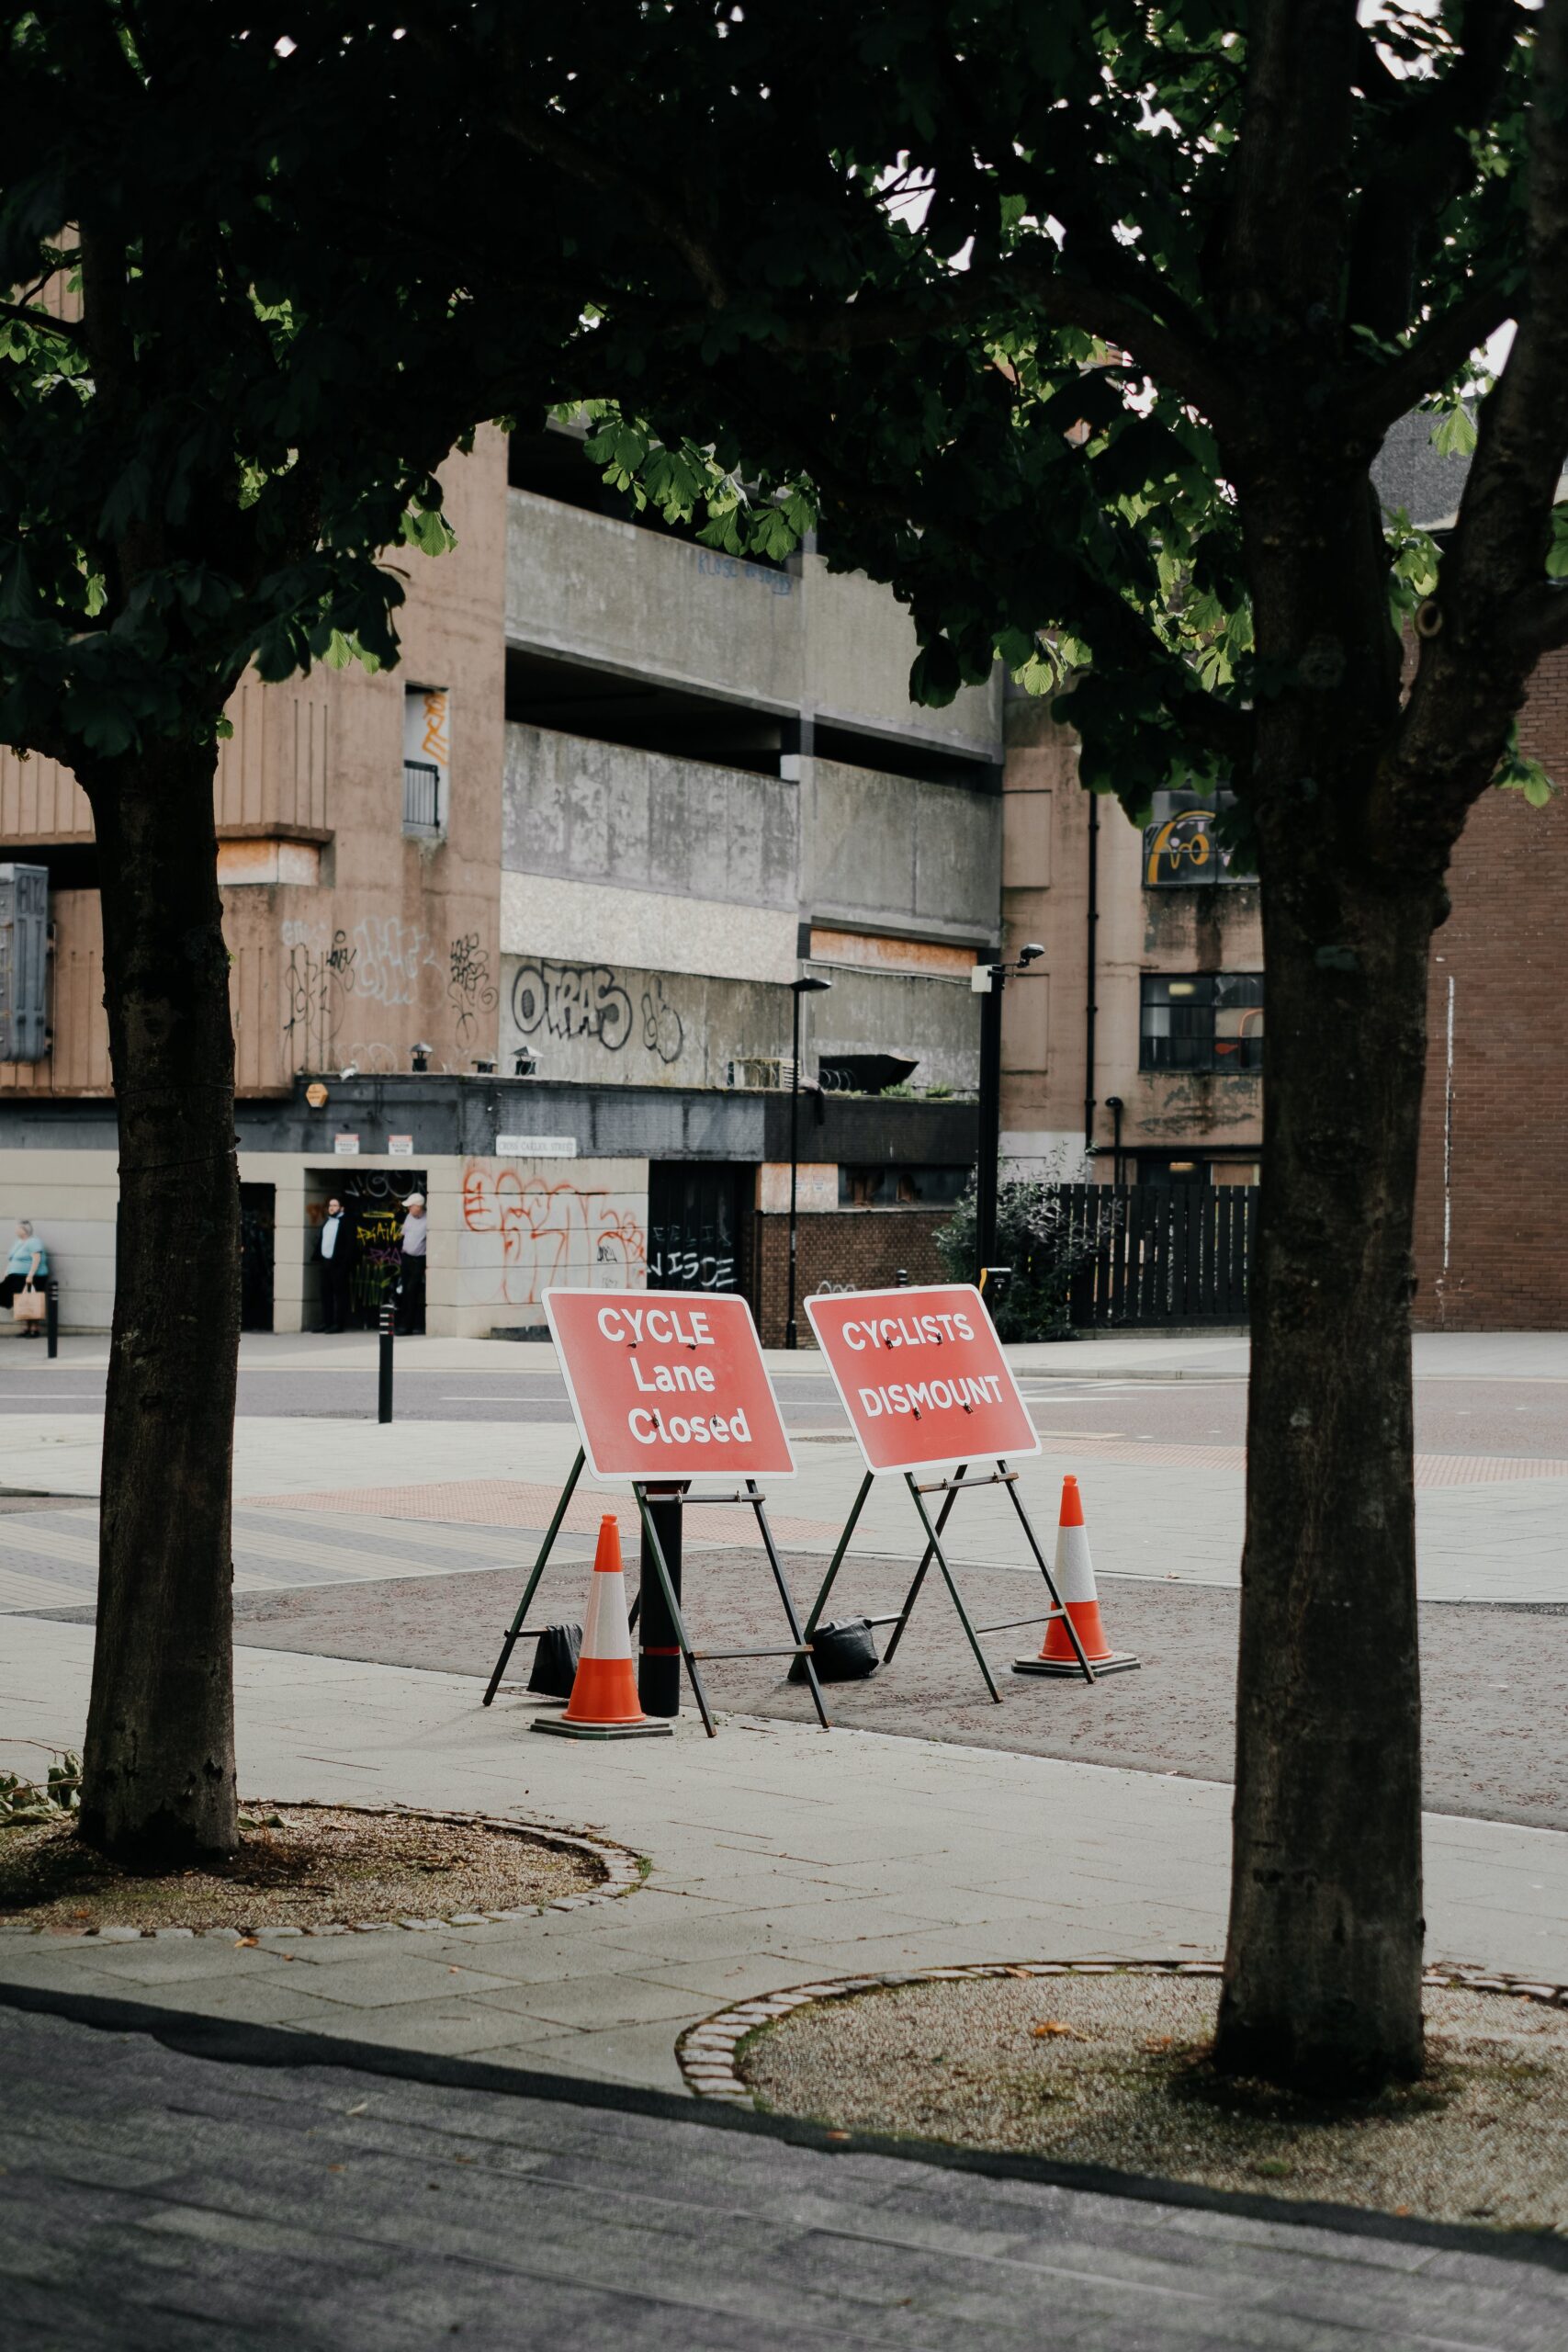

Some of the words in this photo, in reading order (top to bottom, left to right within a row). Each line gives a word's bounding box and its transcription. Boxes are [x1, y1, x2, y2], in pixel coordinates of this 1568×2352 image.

[598, 1307, 715, 1345] CYCLE
[842, 1313, 975, 1351] CYCLISTS
[629, 1357, 716, 1392] Lane
[858, 1375, 1003, 1418] DISMOUNT
[628, 1408, 752, 1444] Closed
